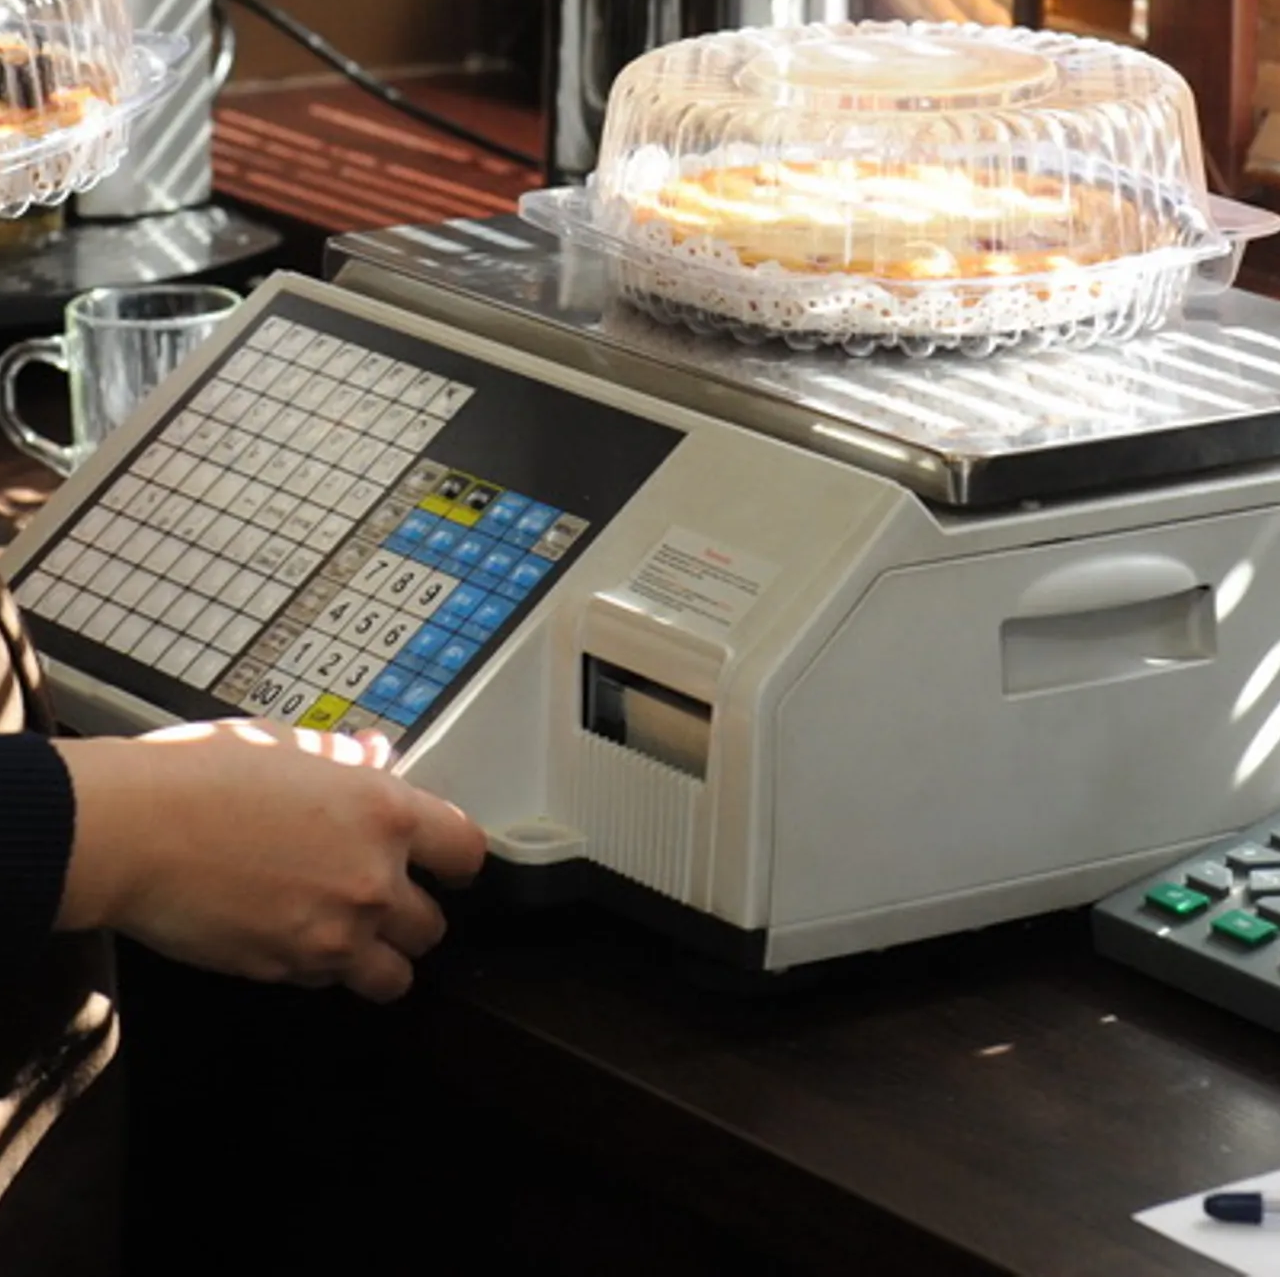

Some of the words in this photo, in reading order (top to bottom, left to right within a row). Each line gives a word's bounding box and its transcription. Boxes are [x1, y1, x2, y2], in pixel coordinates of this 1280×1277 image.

[365, 560, 389, 581] 7
[390, 572, 415, 594] 8
[419, 583, 443, 605] 9
[328, 601, 352, 622] 4
[354, 612, 380, 634] 5
[383, 624, 407, 647] 6
[294, 642, 312, 663] 1
[317, 653, 342, 676] 2
[345, 665, 369, 688] 3
[281, 693, 304, 715] 0
